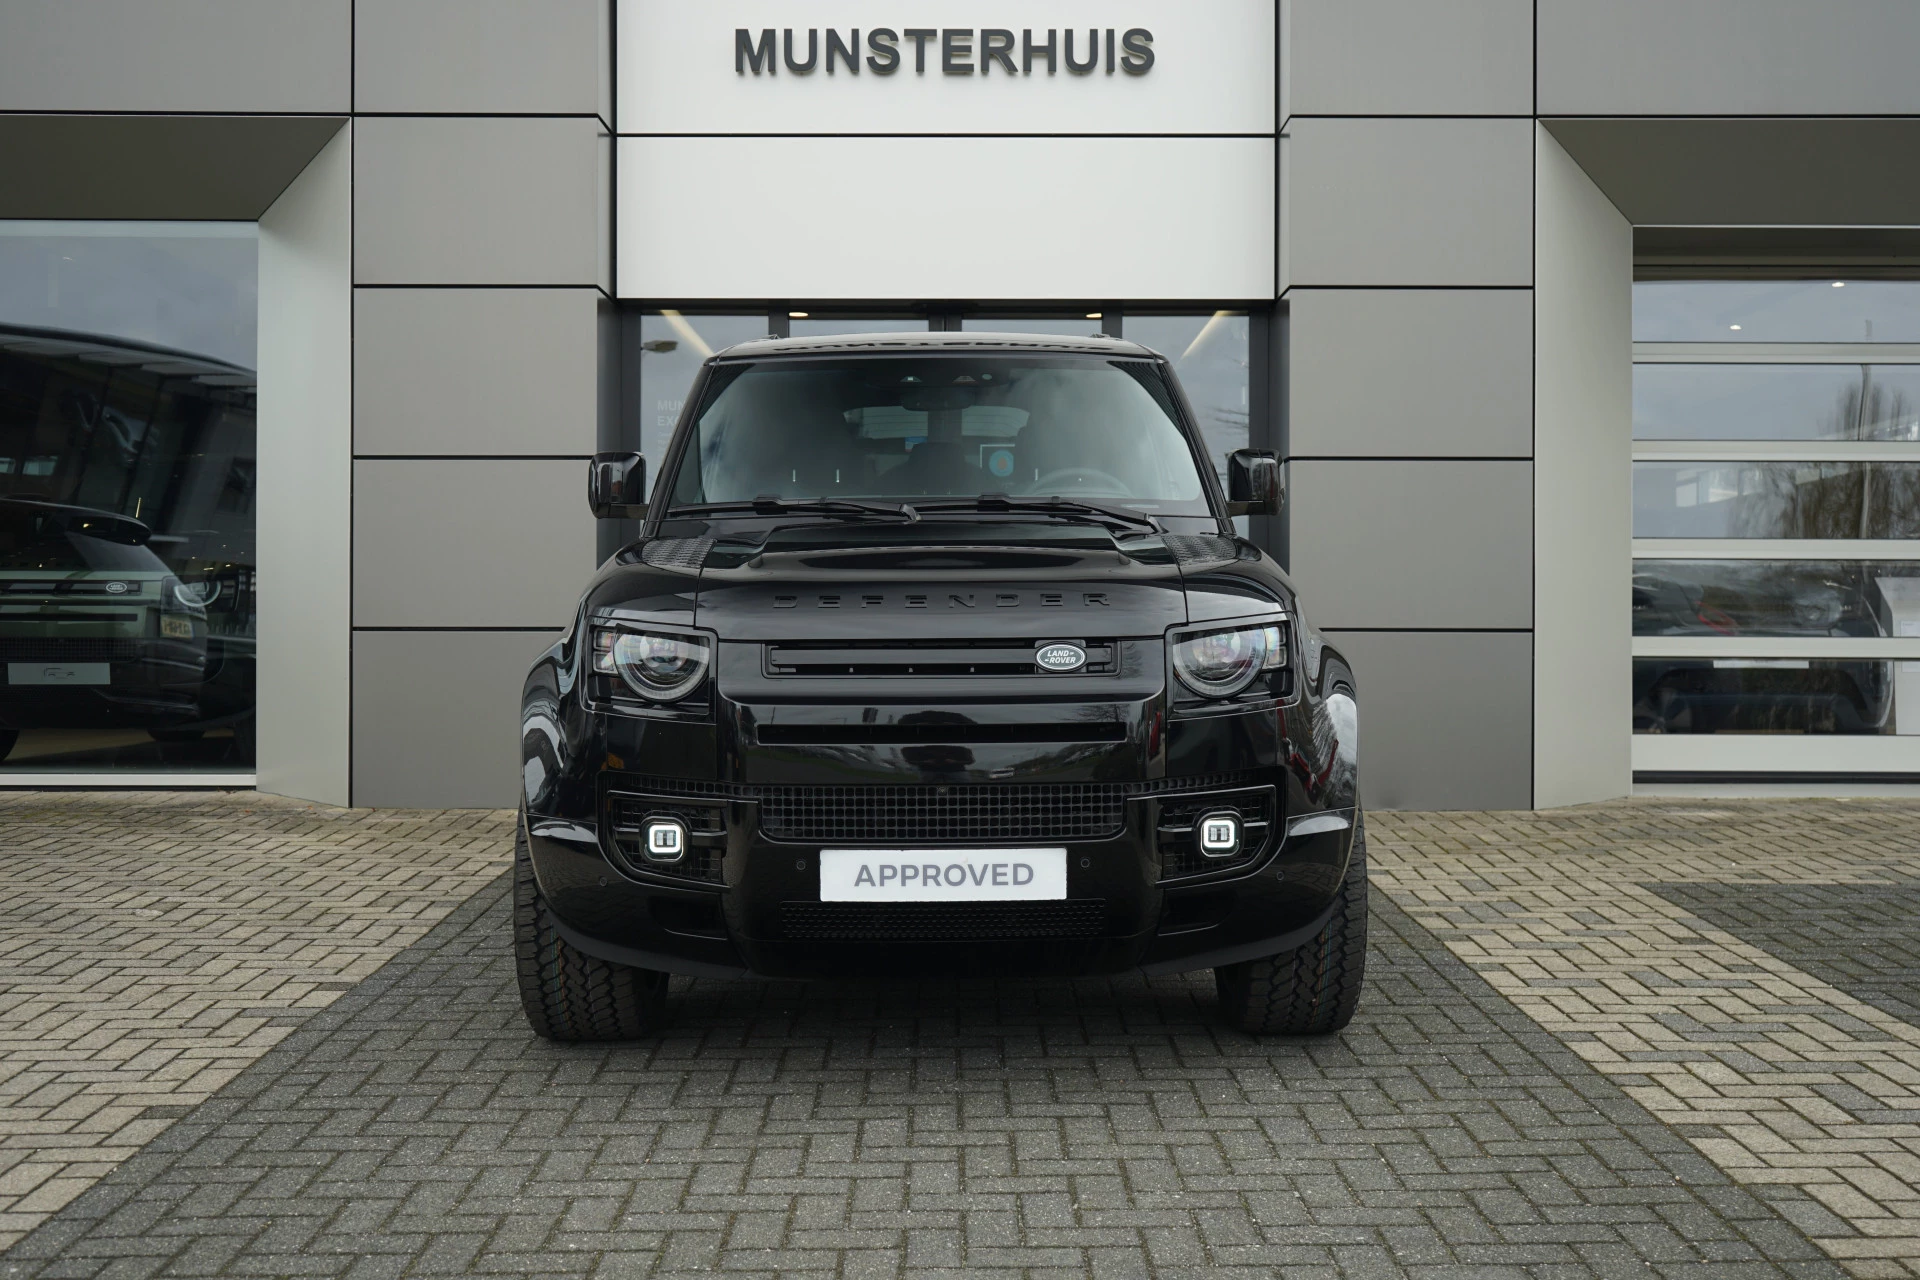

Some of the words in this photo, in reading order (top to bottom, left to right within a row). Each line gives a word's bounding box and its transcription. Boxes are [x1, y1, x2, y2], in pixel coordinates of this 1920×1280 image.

[735, 28, 1155, 74] MUNSTERHUIS
[773, 593, 1110, 609] DEFENDER
[854, 863, 1034, 887] APPROVED
